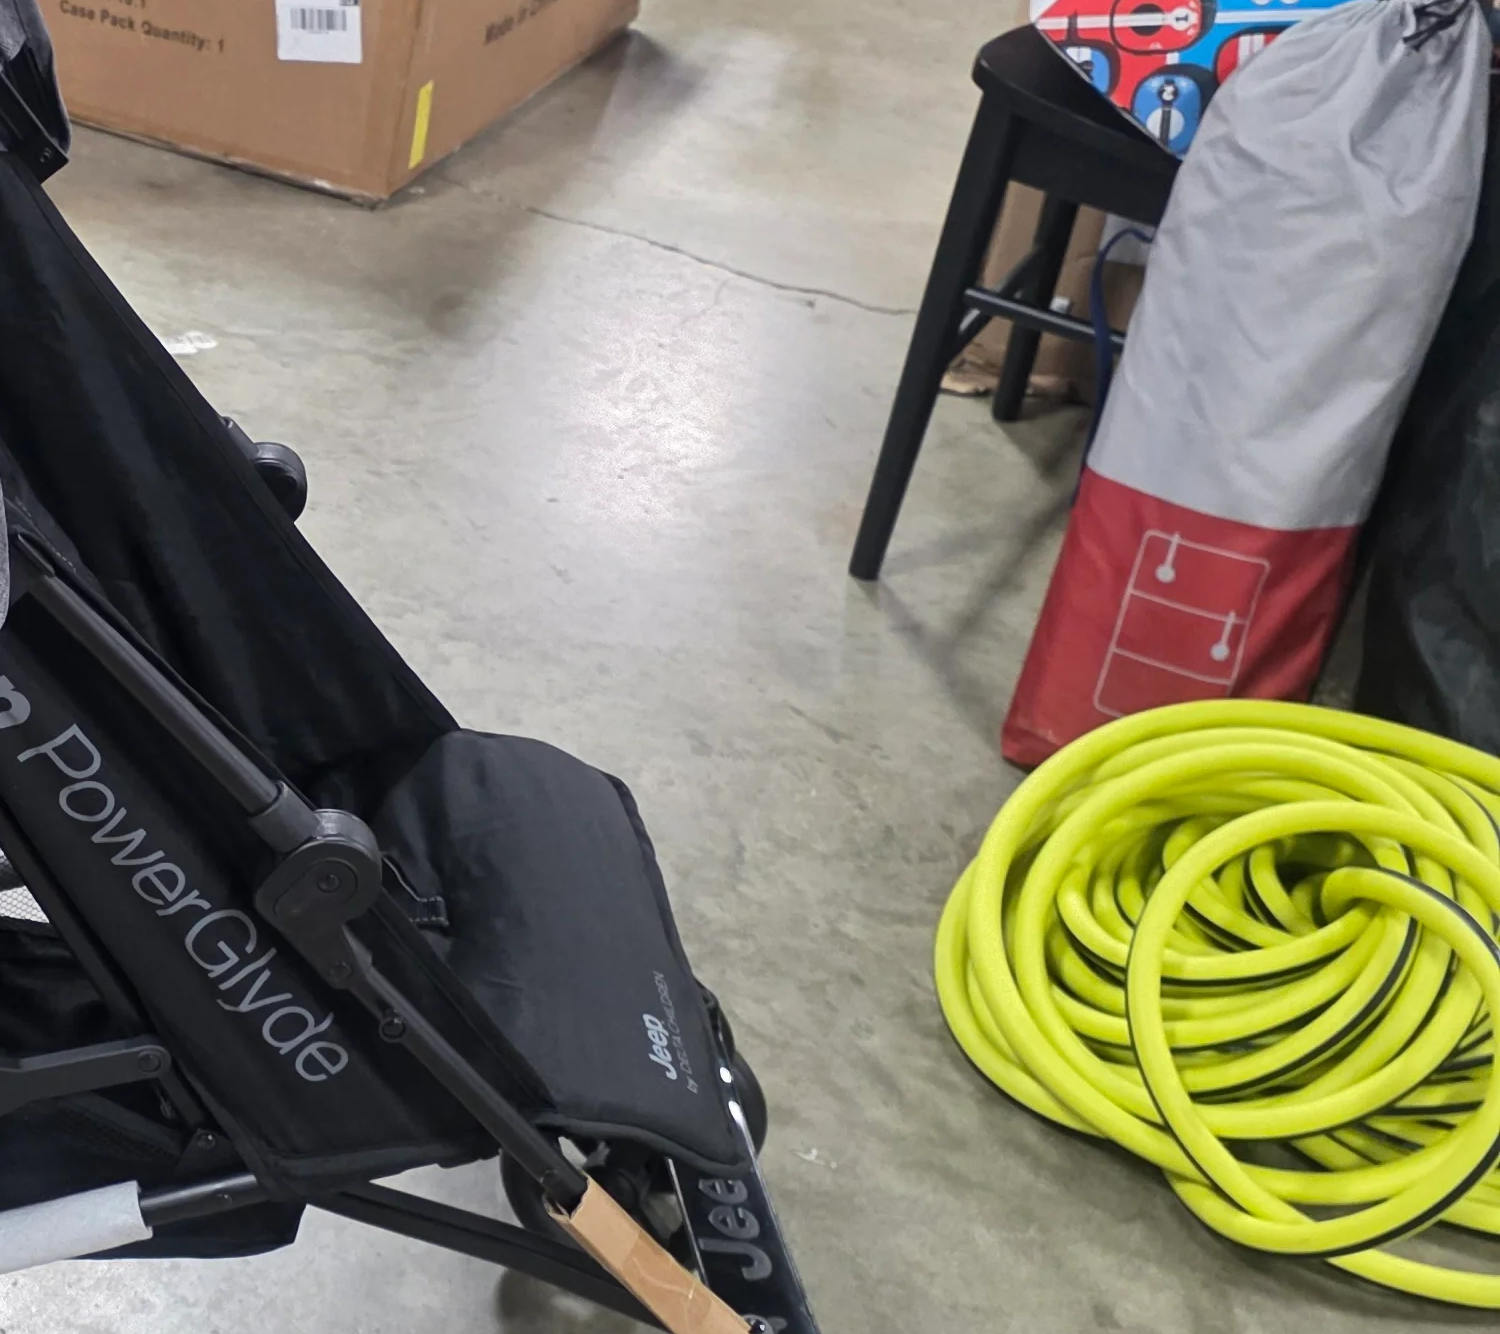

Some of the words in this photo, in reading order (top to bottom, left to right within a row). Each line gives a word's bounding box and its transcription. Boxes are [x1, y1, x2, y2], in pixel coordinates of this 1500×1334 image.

[59, 0, 96, 22] Case
[100, 8, 136, 31] Pack
[141, 19, 212, 51] Quantity:
[16, 723, 350, 1083] PowerGlyde
[642, 1013, 679, 1081] Jeep
[686, 1074, 699, 1094] by
[697, 1178, 773, 1281] Jee
